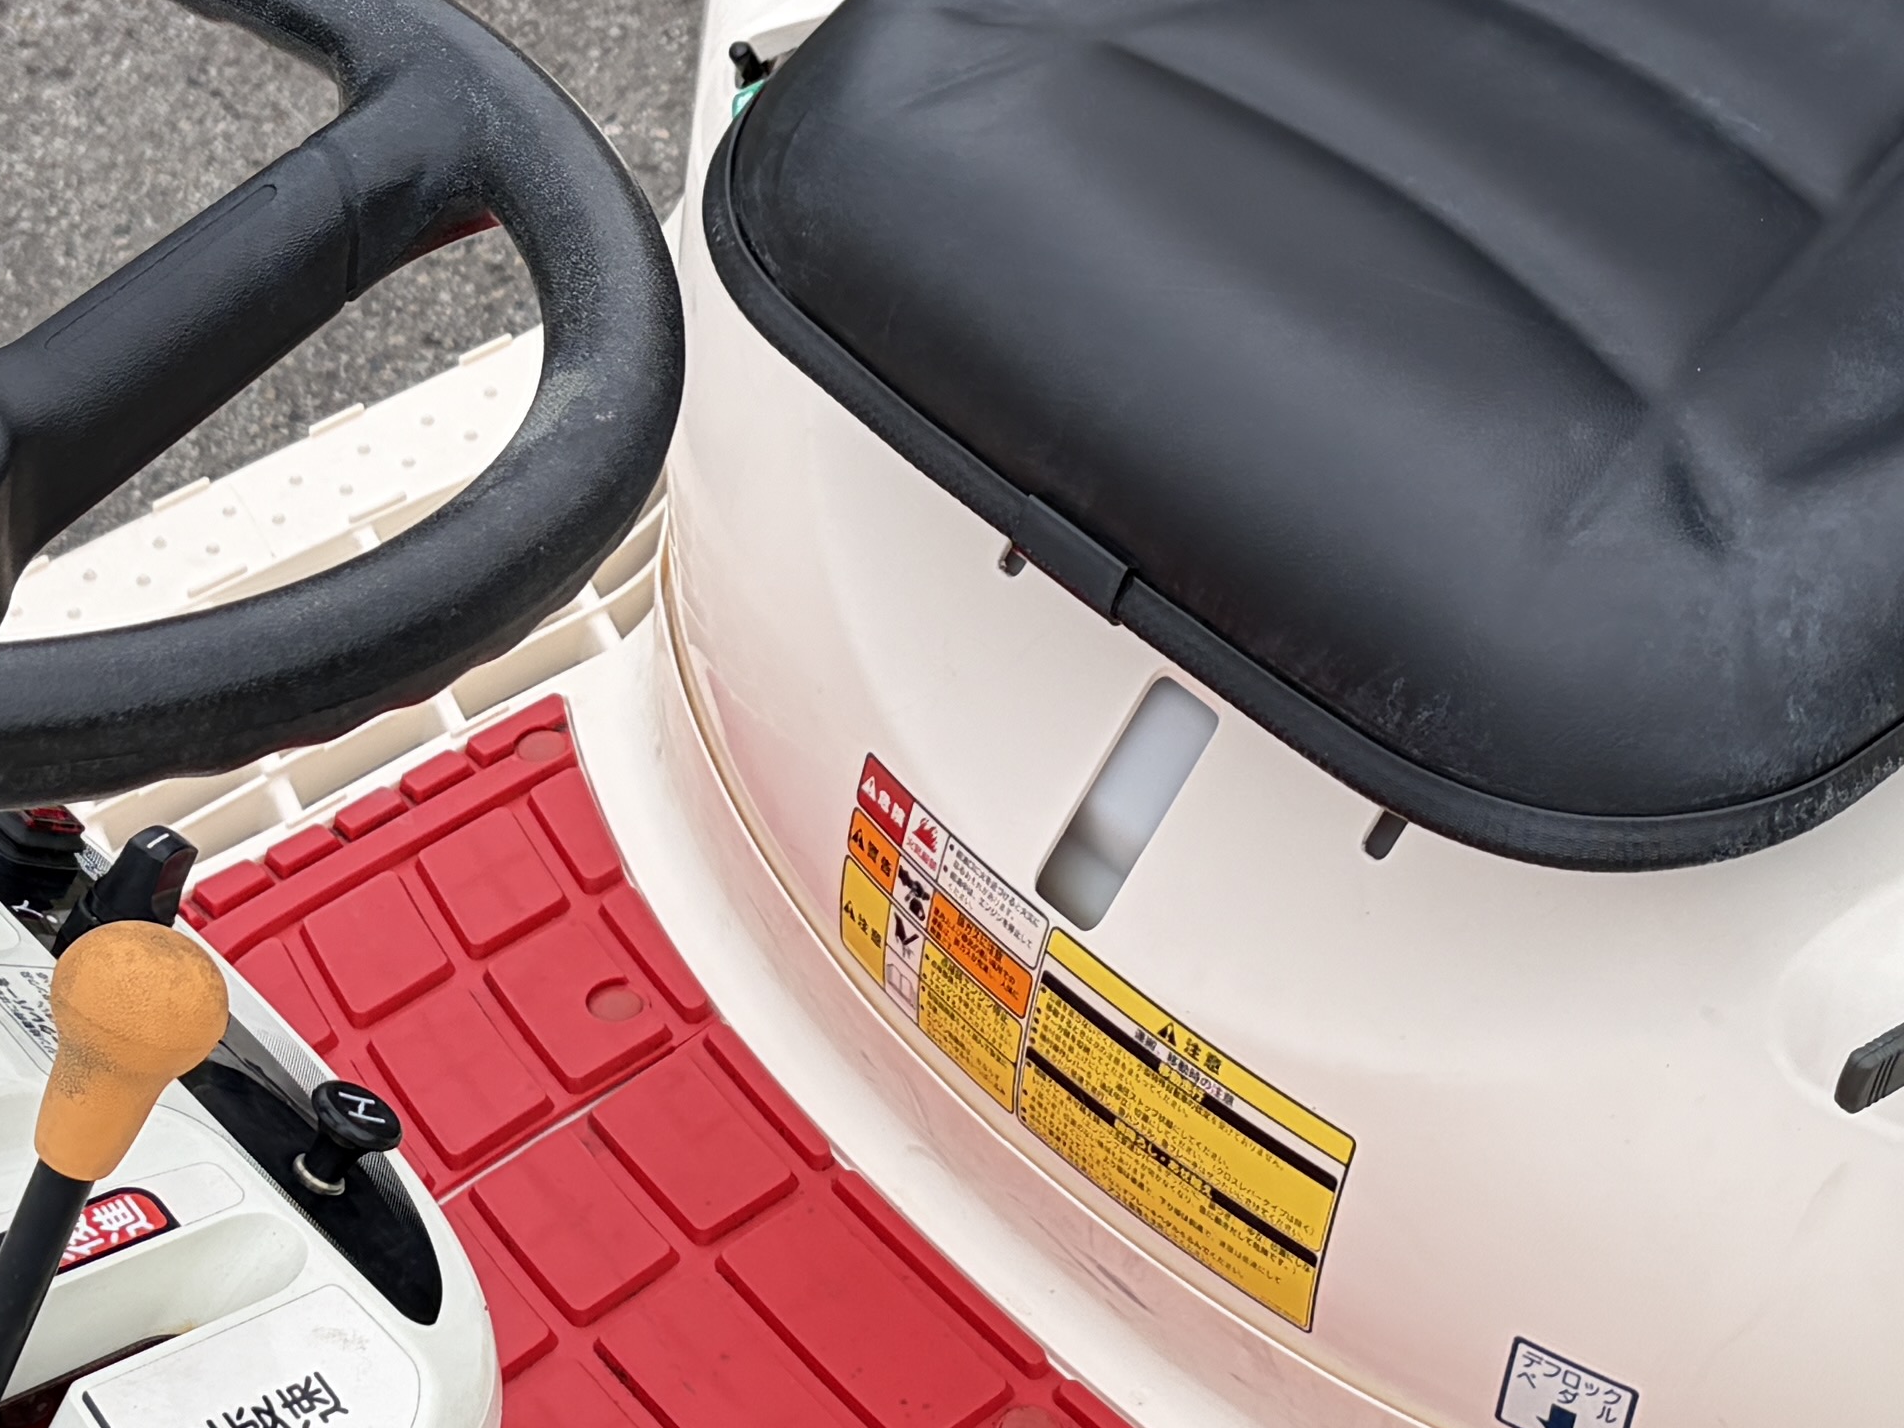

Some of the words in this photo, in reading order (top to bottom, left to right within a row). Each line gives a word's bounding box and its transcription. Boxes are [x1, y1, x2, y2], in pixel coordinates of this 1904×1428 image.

[1183, 1035, 1222, 1076] 注意
[1521, 1350, 1622, 1405] デフロック
